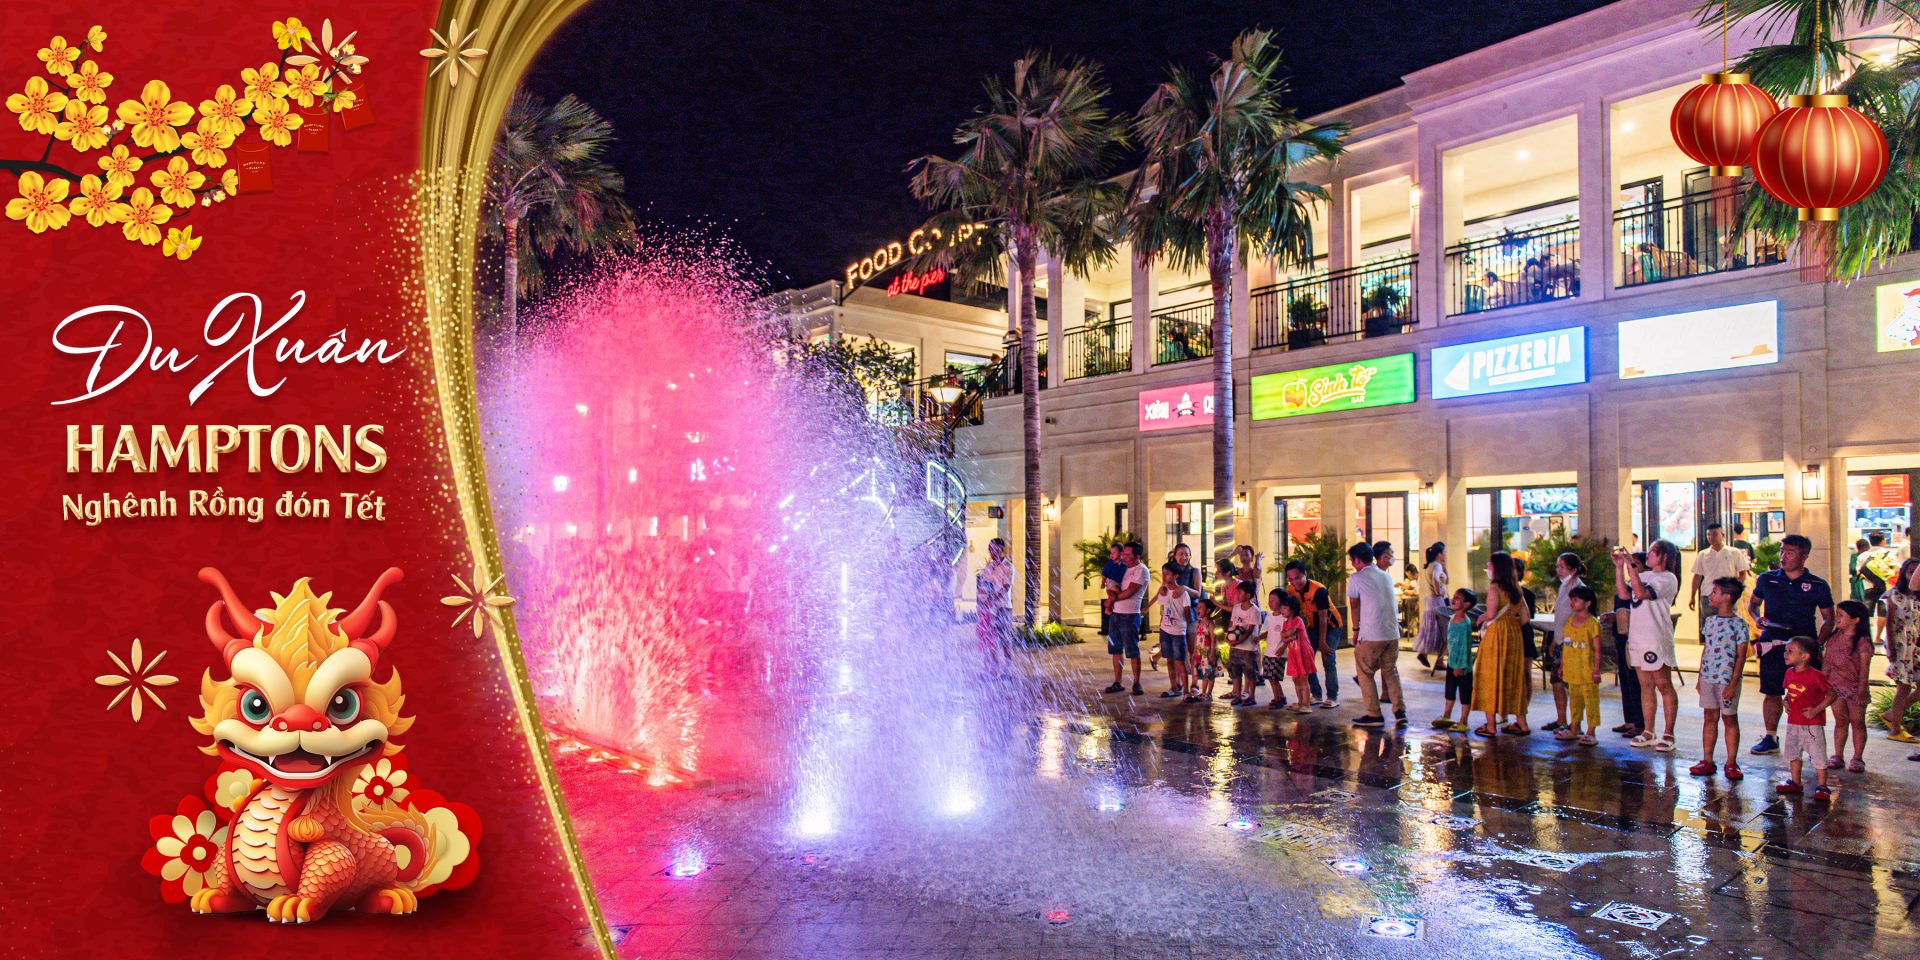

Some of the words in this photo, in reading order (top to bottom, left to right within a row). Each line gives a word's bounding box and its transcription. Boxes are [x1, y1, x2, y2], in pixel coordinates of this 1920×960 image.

[845, 241, 902, 289] FOOD
[887, 277, 901, 298] at
[901, 271, 919, 293] the
[919, 267, 945, 296] pier
[1472, 333, 1572, 379] PIZZERIA
[1308, 373, 1348, 408] Sinh
